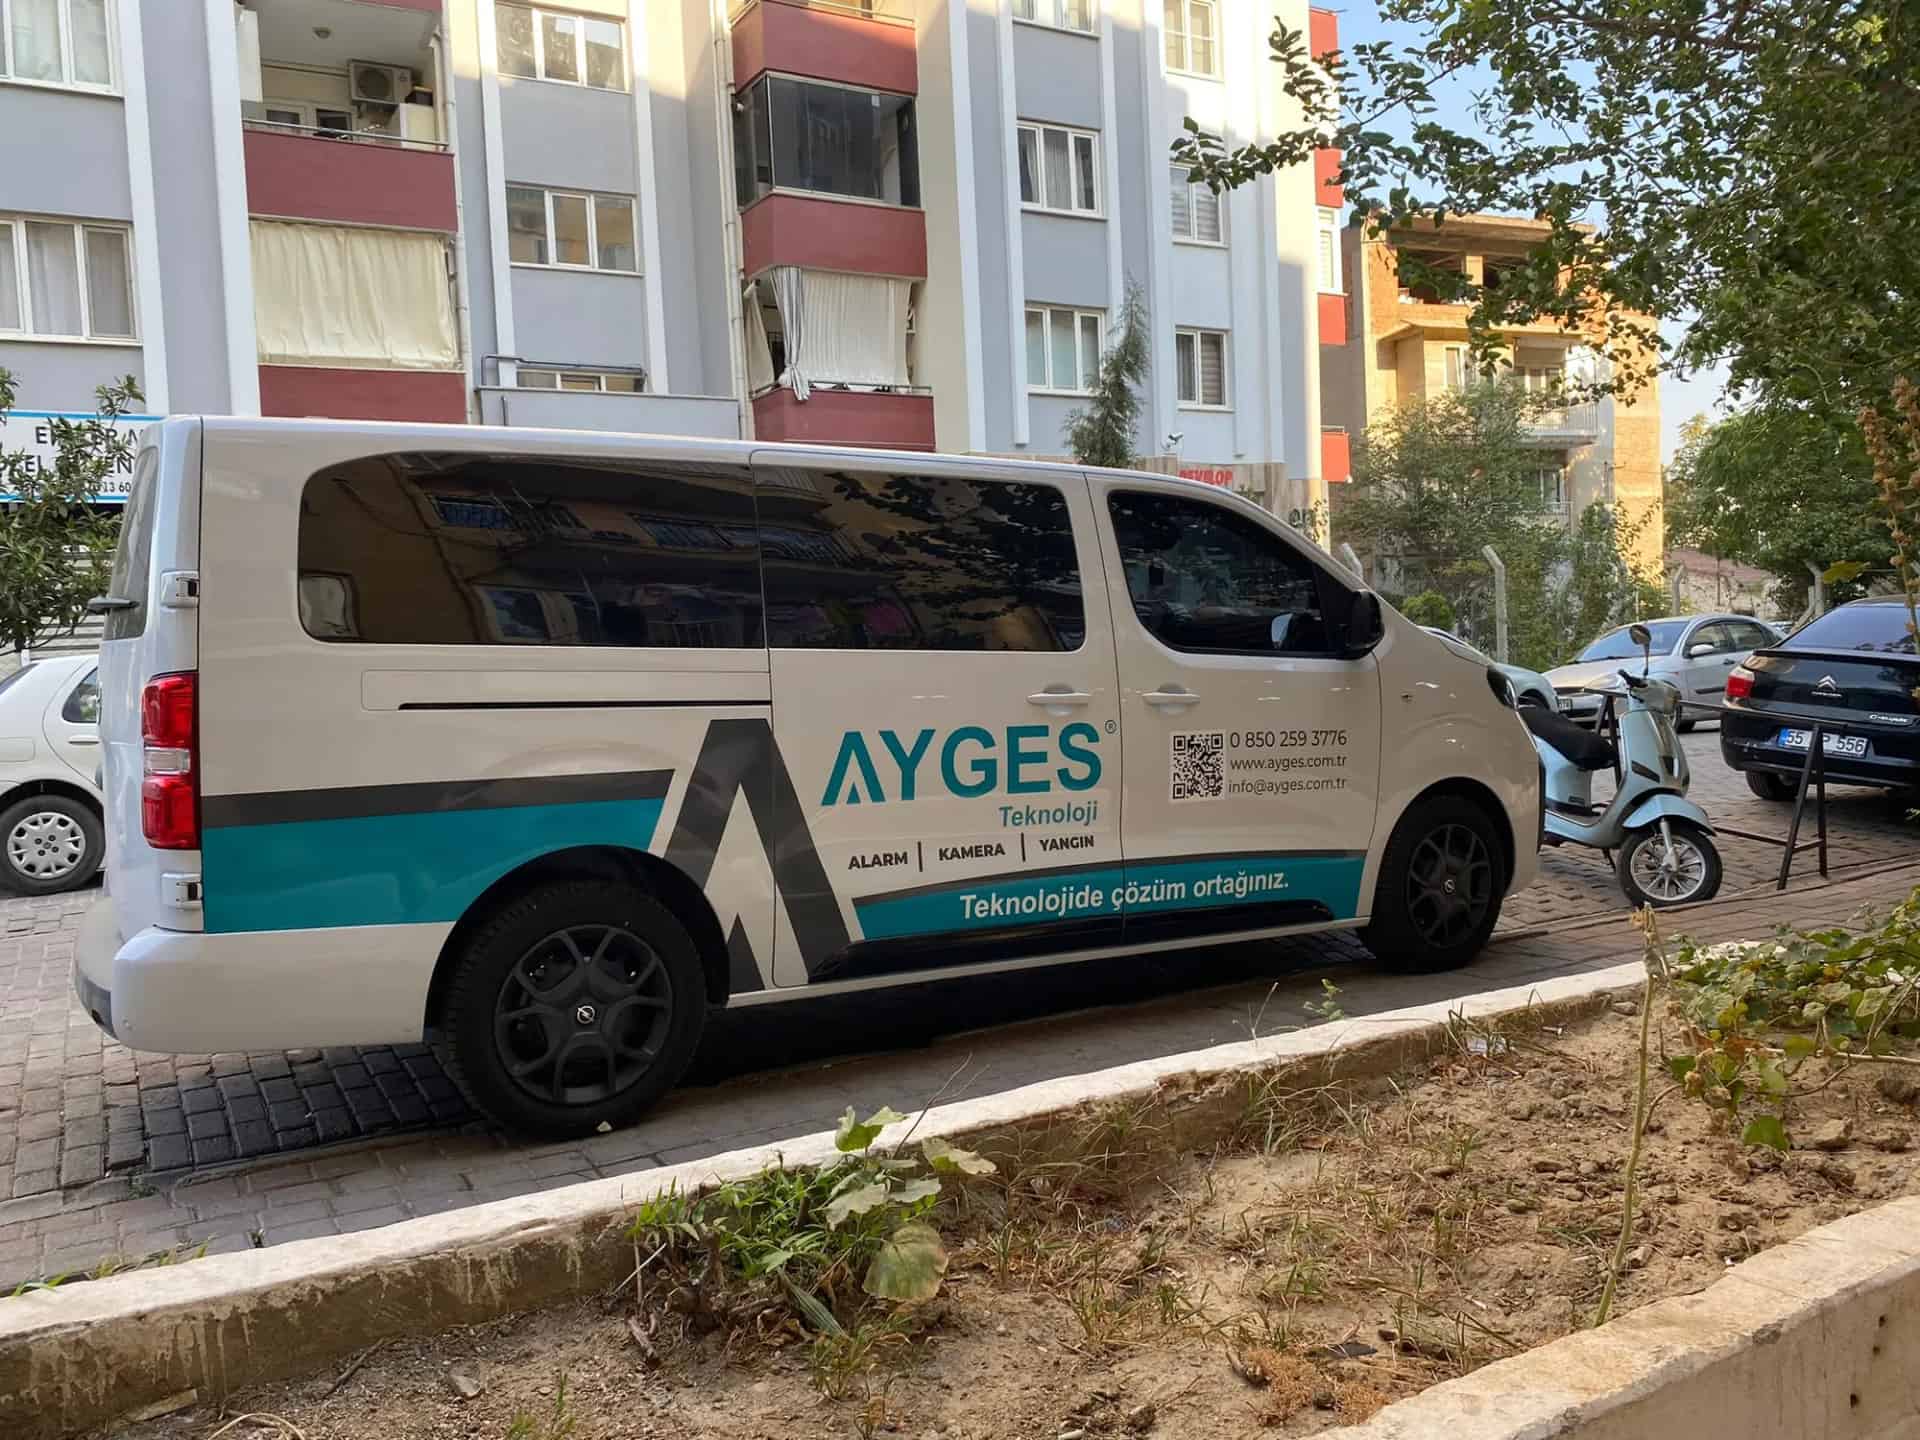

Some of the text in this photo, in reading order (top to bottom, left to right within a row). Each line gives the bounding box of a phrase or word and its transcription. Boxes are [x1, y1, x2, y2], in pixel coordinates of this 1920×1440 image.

[1230, 730, 1347, 748] 0 850 259 3776
[820, 722, 1102, 807] AYGES
[1230, 756, 1347, 772] www.ayges.com.tr
[1228, 777, 1347, 796] info@ayges.com.tr
[998, 800, 1098, 828] Teknoloji
[848, 835, 1095, 870] ALARM KAMERA YANGIN
[960, 871, 1289, 919] Teknolojide çözüm ortağınız.
